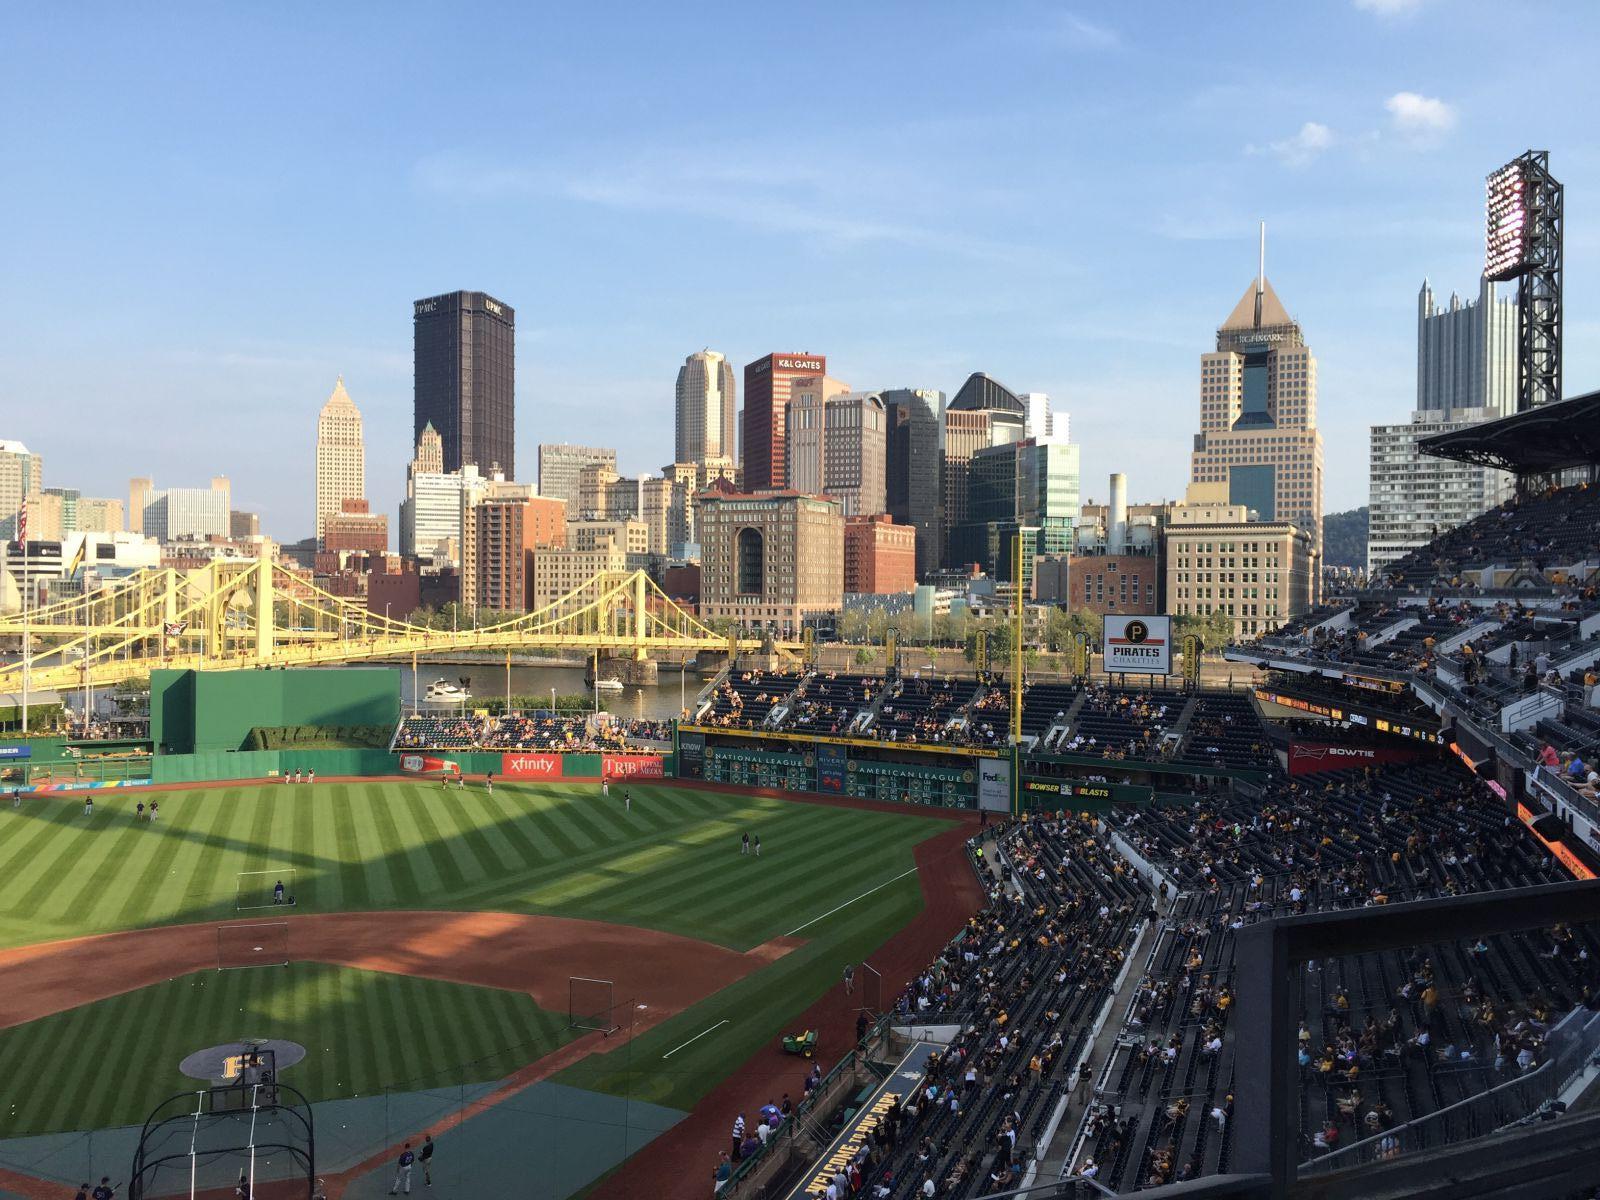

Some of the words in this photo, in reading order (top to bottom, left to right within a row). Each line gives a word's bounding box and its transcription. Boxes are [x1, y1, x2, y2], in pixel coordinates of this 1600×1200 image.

[486, 300, 503, 316] UPMC
[778, 359, 794, 368] K&L
[794, 360, 821, 370] GATES
[1132, 625, 1142, 640] P
[1113, 647, 1160, 658] PIRATES
[1112, 656, 1160, 665] CHARITIES
[1329, 747, 1375, 758] BOWTIE
[511, 757, 554, 772] xfinity
[603, 758, 637, 774] TRIB
[639, 760, 662, 768] TOTAL
[714, 753, 763, 764] NATIONAL
[765, 757, 803, 767] LEAGUE
[639, 766, 663, 775] MEDIA
[859, 767, 915, 778] AMERICAN
[918, 772, 961, 783] LEAGUE
[1029, 782, 1060, 793] BOWSER
[1079, 787, 1109, 797] BLASTS
[804, 1143, 861, 1193] WELCOME
[848, 1133, 867, 1143] TO
[870, 1091, 903, 1115] PARK
